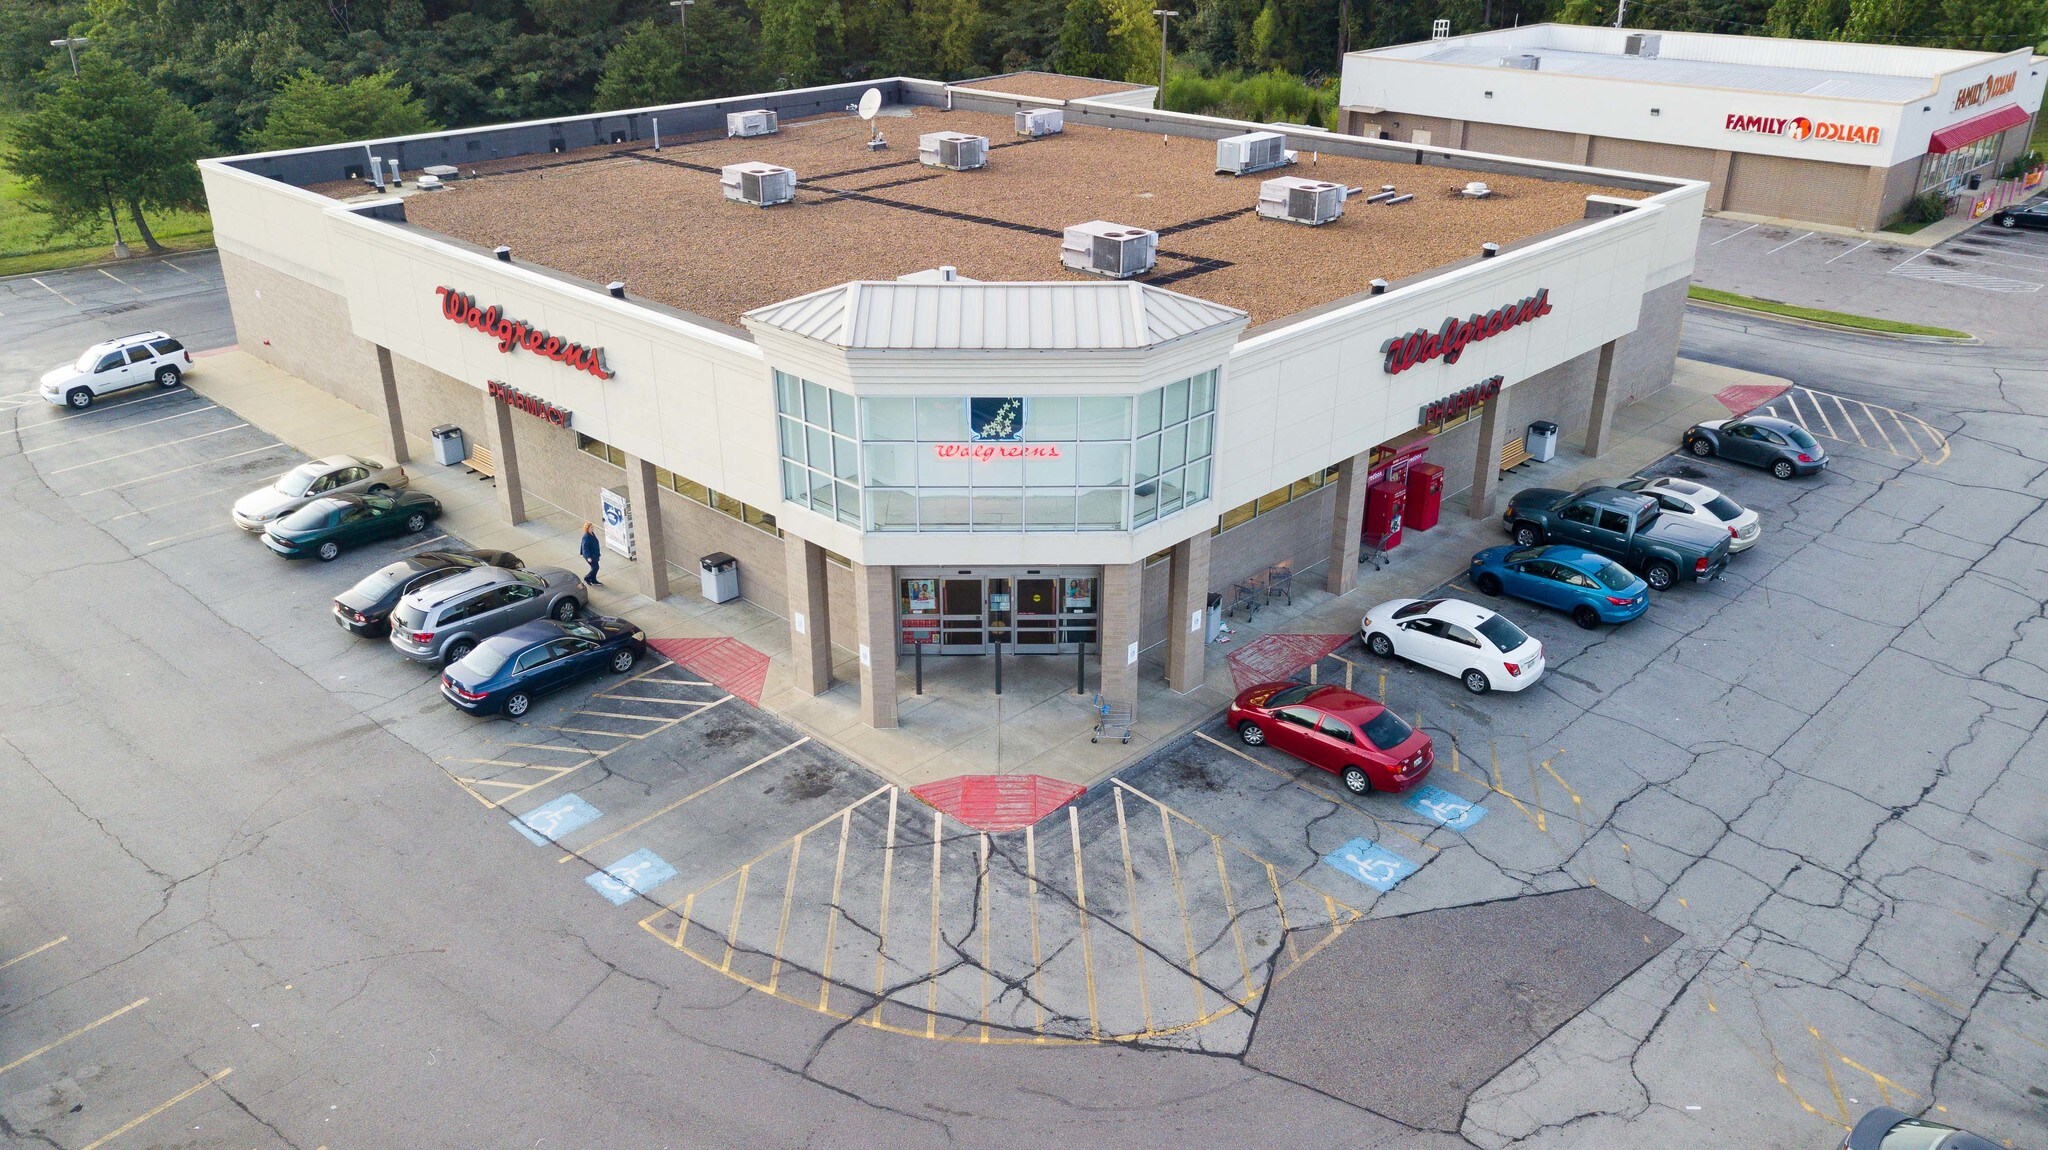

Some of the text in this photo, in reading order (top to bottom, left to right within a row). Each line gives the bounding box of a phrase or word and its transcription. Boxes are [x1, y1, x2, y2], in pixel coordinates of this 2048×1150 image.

[1955, 70, 2017, 111] FAMILY DOLLAR
[1725, 113, 1882, 145] FAMILY DOLLAR
[436, 285, 614, 380] Walgreens
[1381, 288, 1553, 375] Walgreens
[487, 379, 572, 429] PHARMACY
[1420, 375, 1504, 426] PHARMACY
[935, 444, 1060, 461] Walgreens
